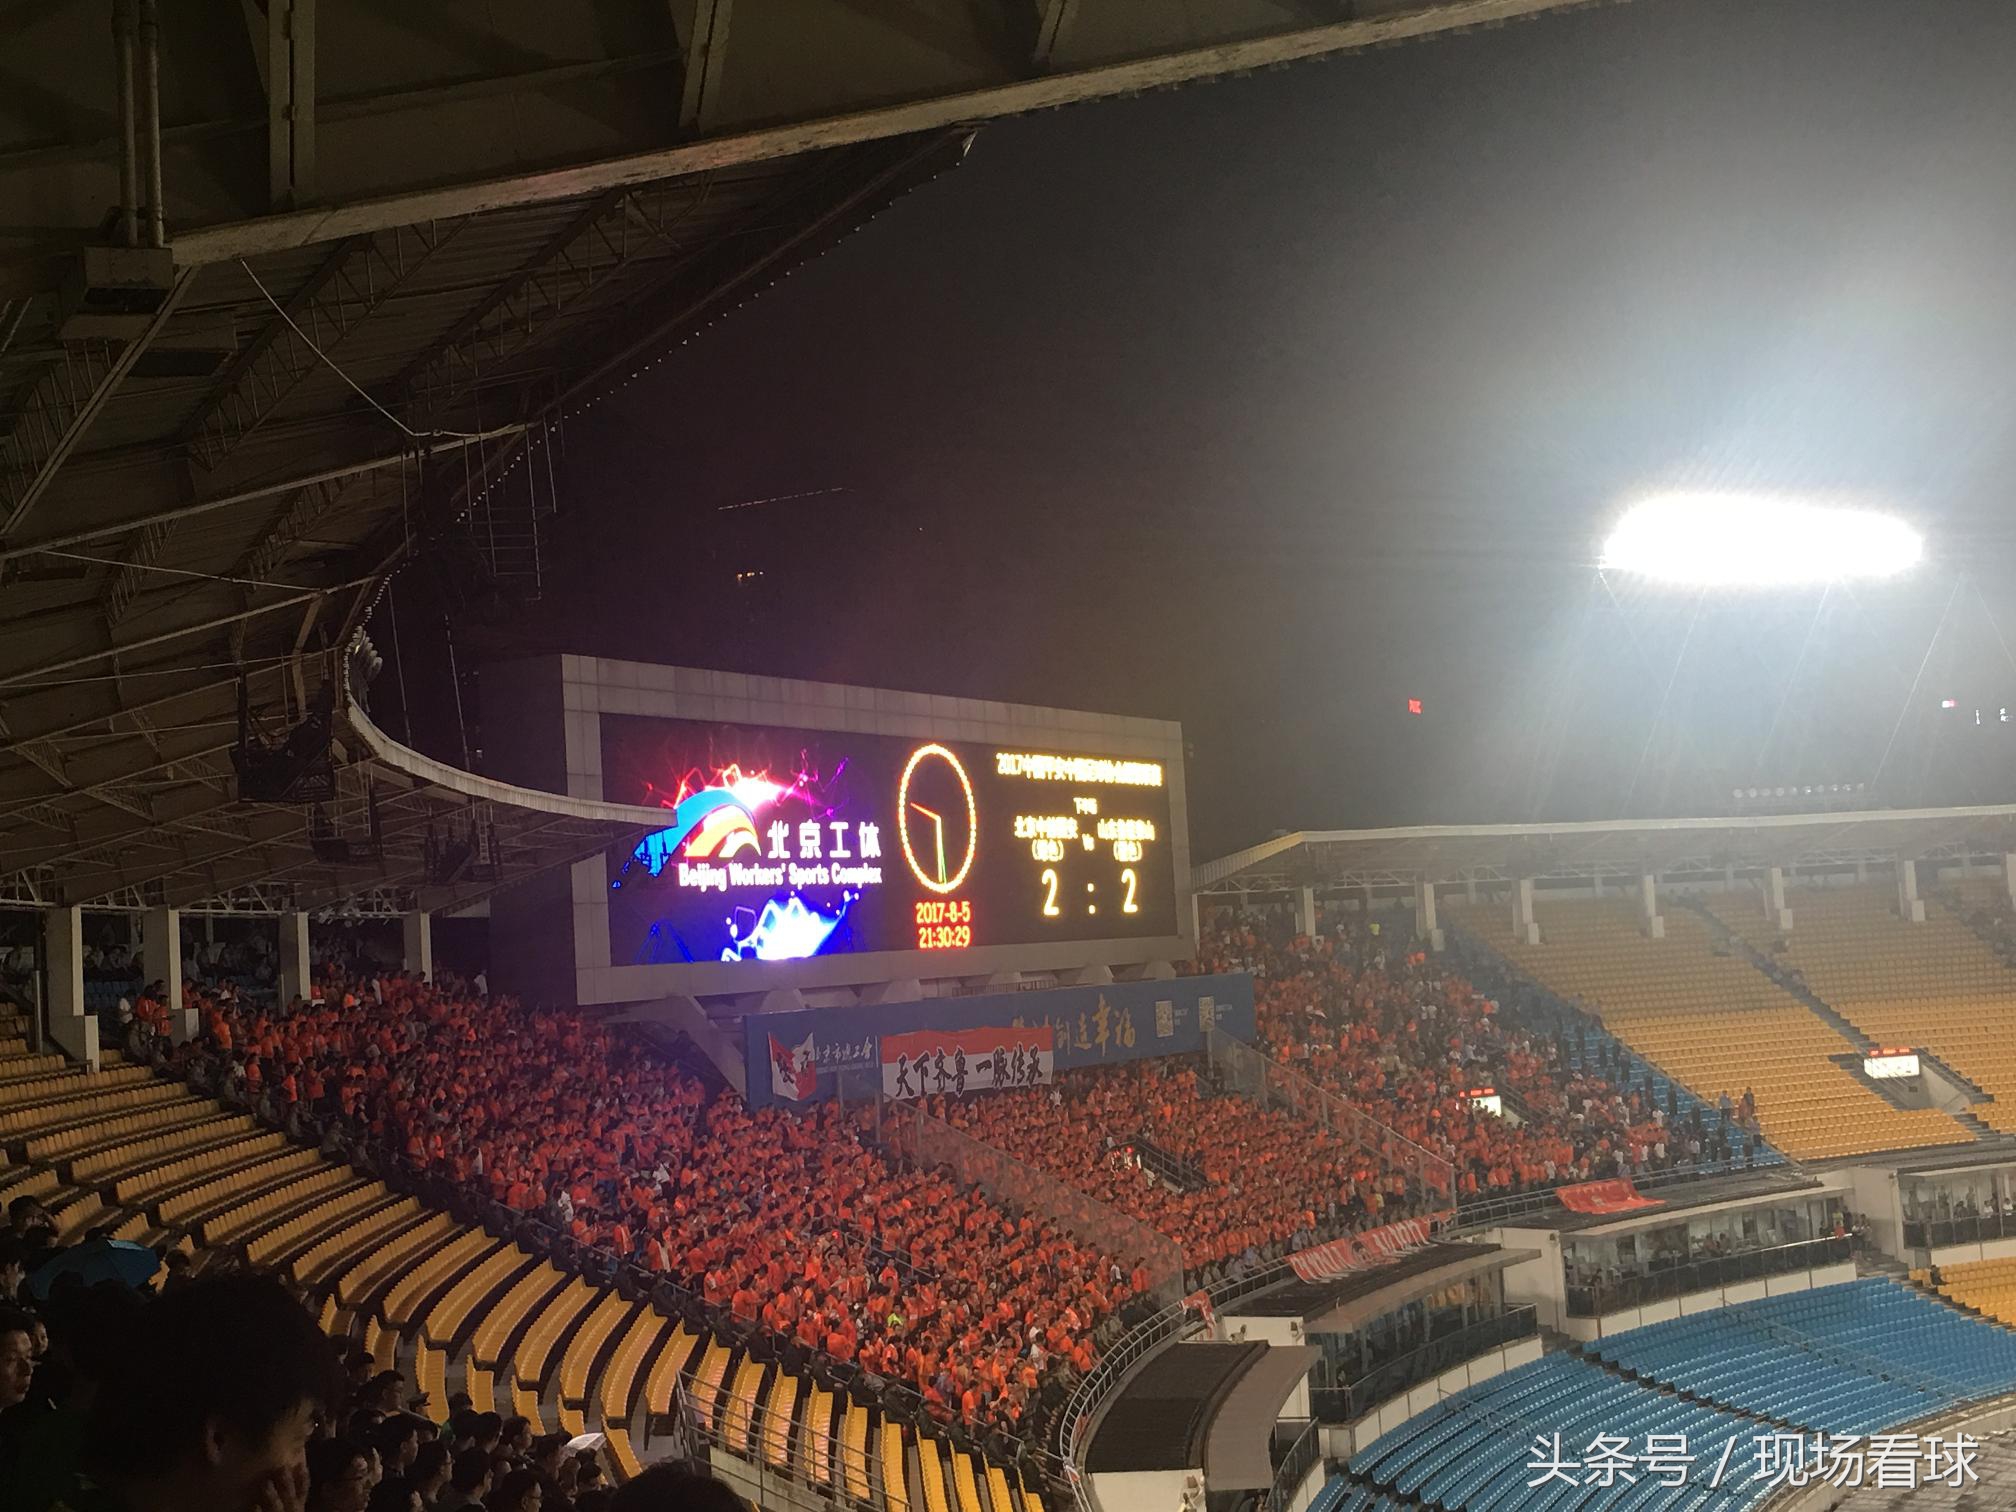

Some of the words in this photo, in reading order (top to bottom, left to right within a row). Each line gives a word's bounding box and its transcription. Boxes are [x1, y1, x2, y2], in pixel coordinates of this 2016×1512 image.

[767, 819, 882, 859] 北京工体
[677, 862, 728, 892] Beijing
[729, 862, 787, 886] Workers'
[788, 863, 829, 890] Sports
[831, 862, 883, 888] Complex
[1041, 868, 1061, 916] 2
[1121, 868, 1138, 914] 2
[915, 900, 971, 924] 2017-8-5
[918, 925, 971, 949] 21:30:29
